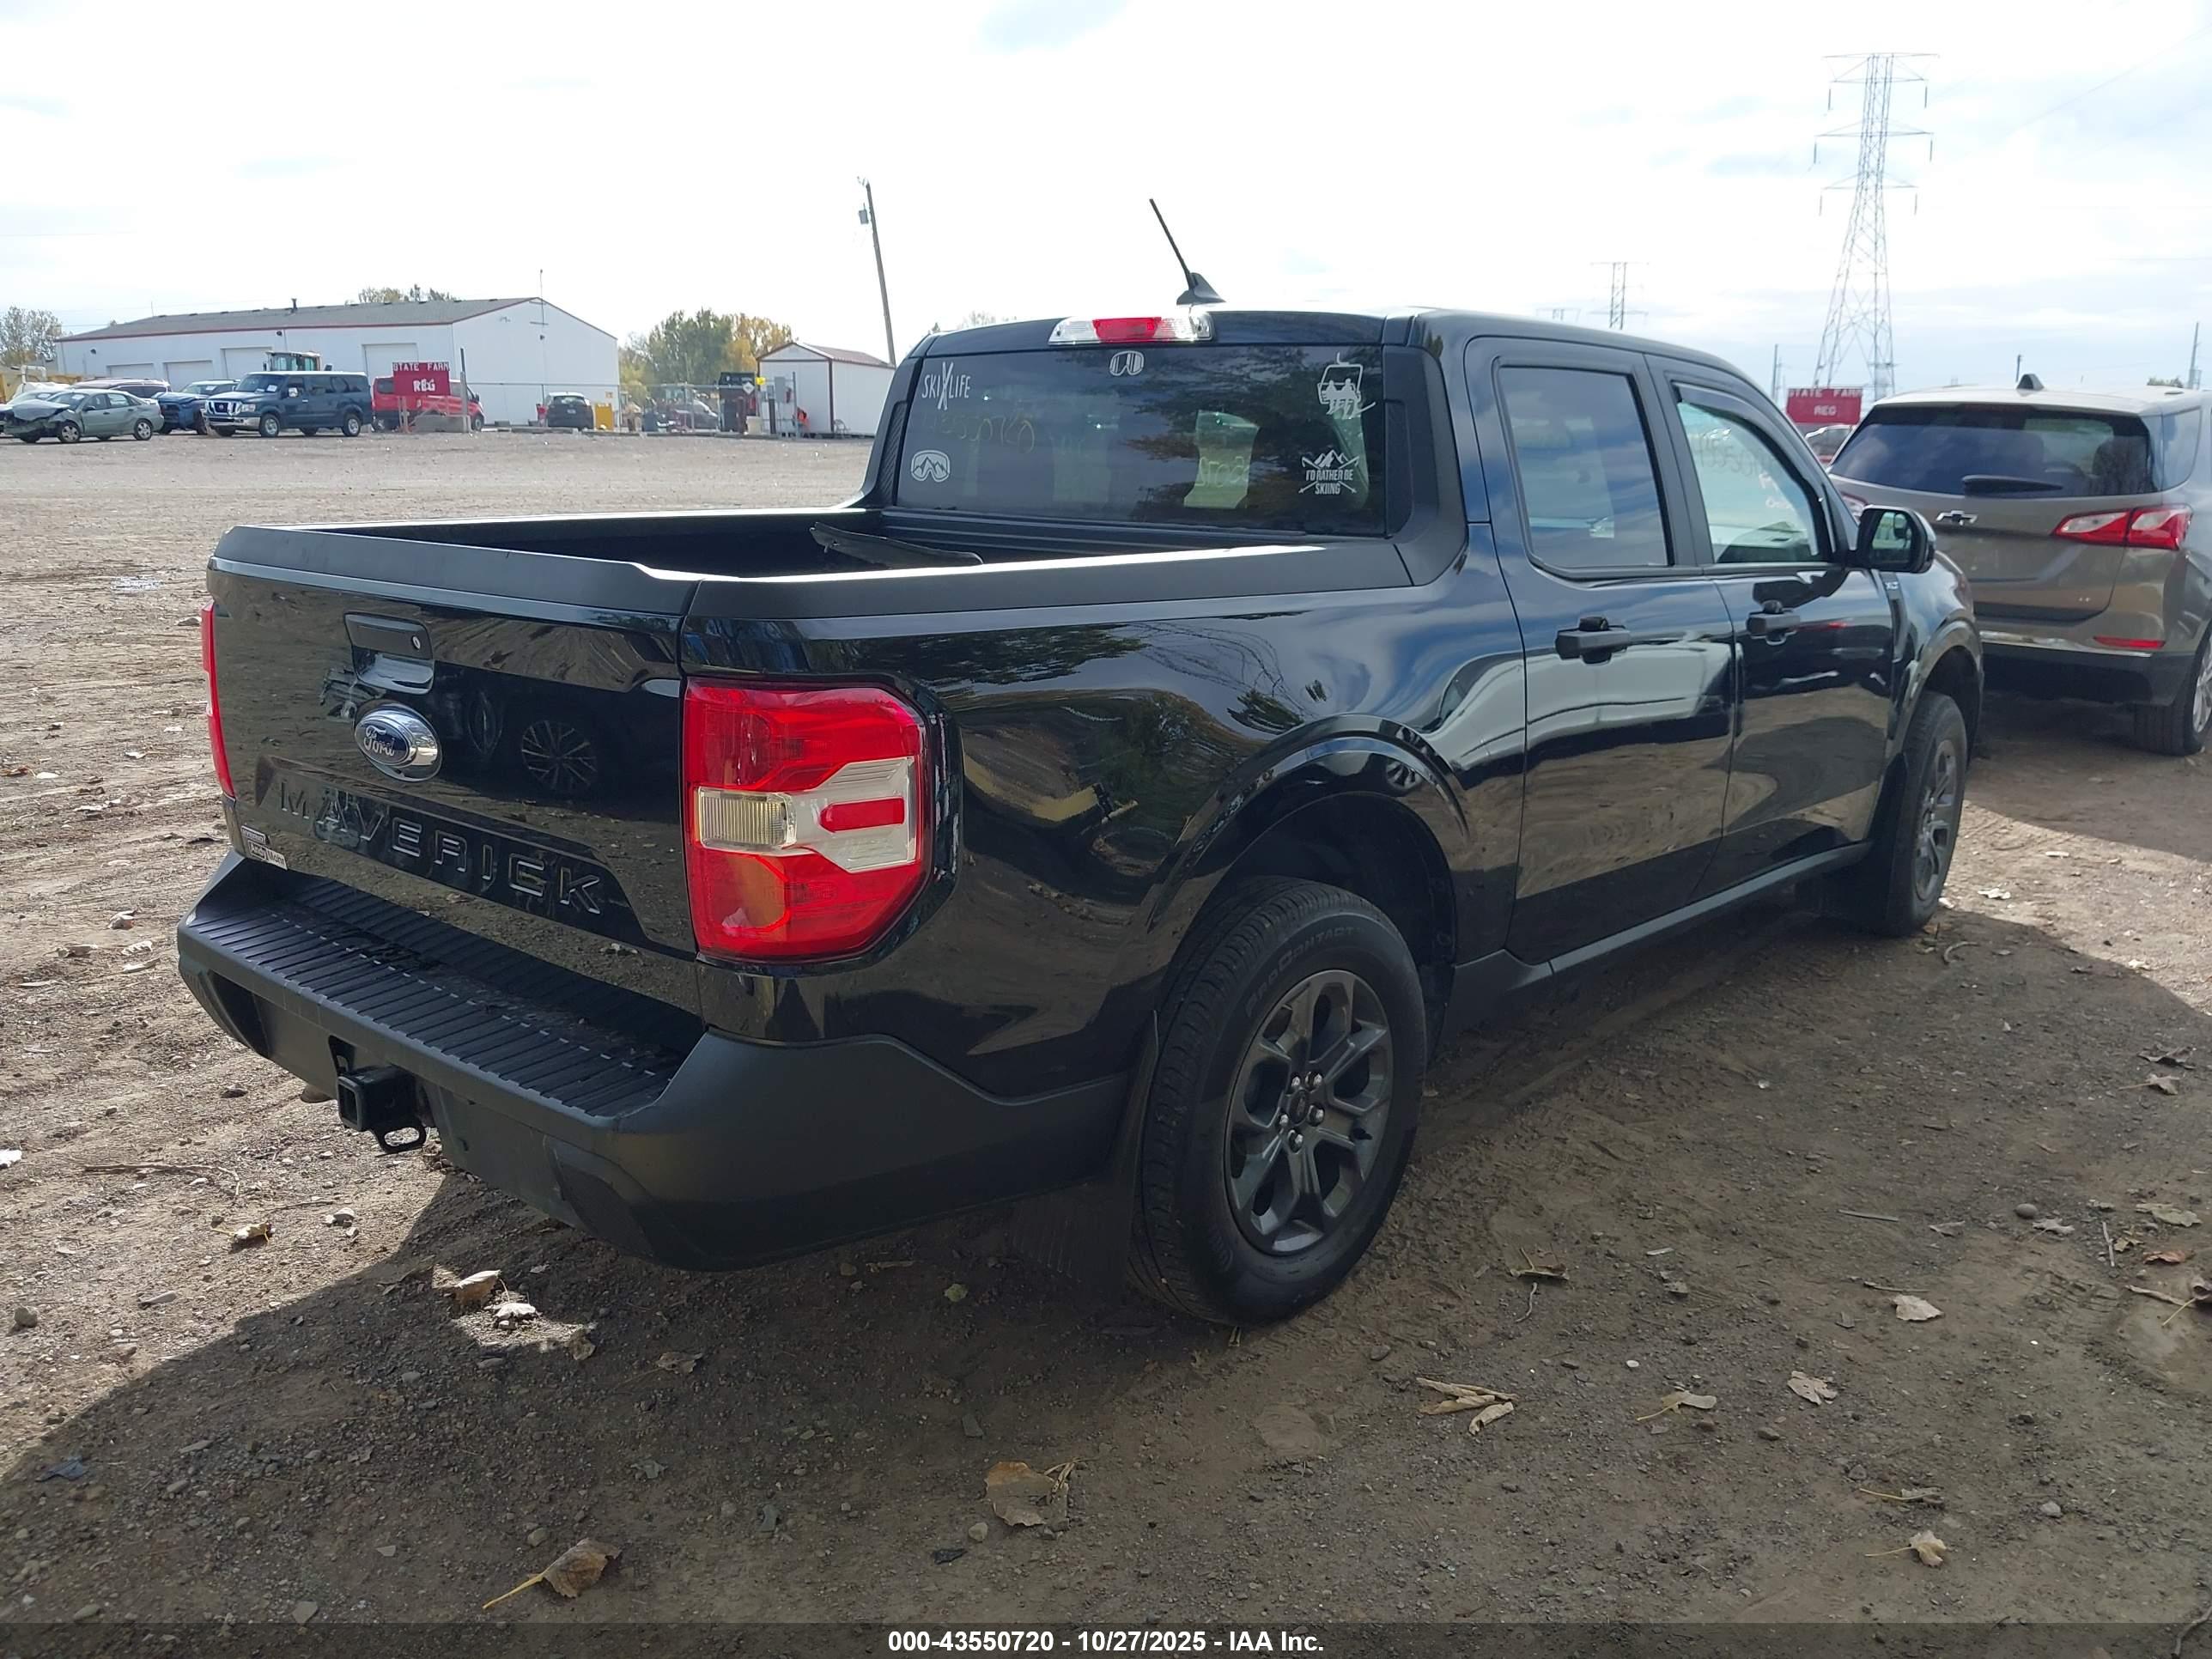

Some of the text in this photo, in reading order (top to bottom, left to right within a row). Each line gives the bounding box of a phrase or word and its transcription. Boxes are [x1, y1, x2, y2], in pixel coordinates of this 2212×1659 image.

[393, 362, 449, 372] STATE FARM
[1316, 469, 1344, 481] RATHER
[1344, 470, 1353, 481] BE
[1315, 483, 1341, 495] SKIING
[363, 724, 396, 757] Ford
[279, 780, 601, 915] MAVERICK
